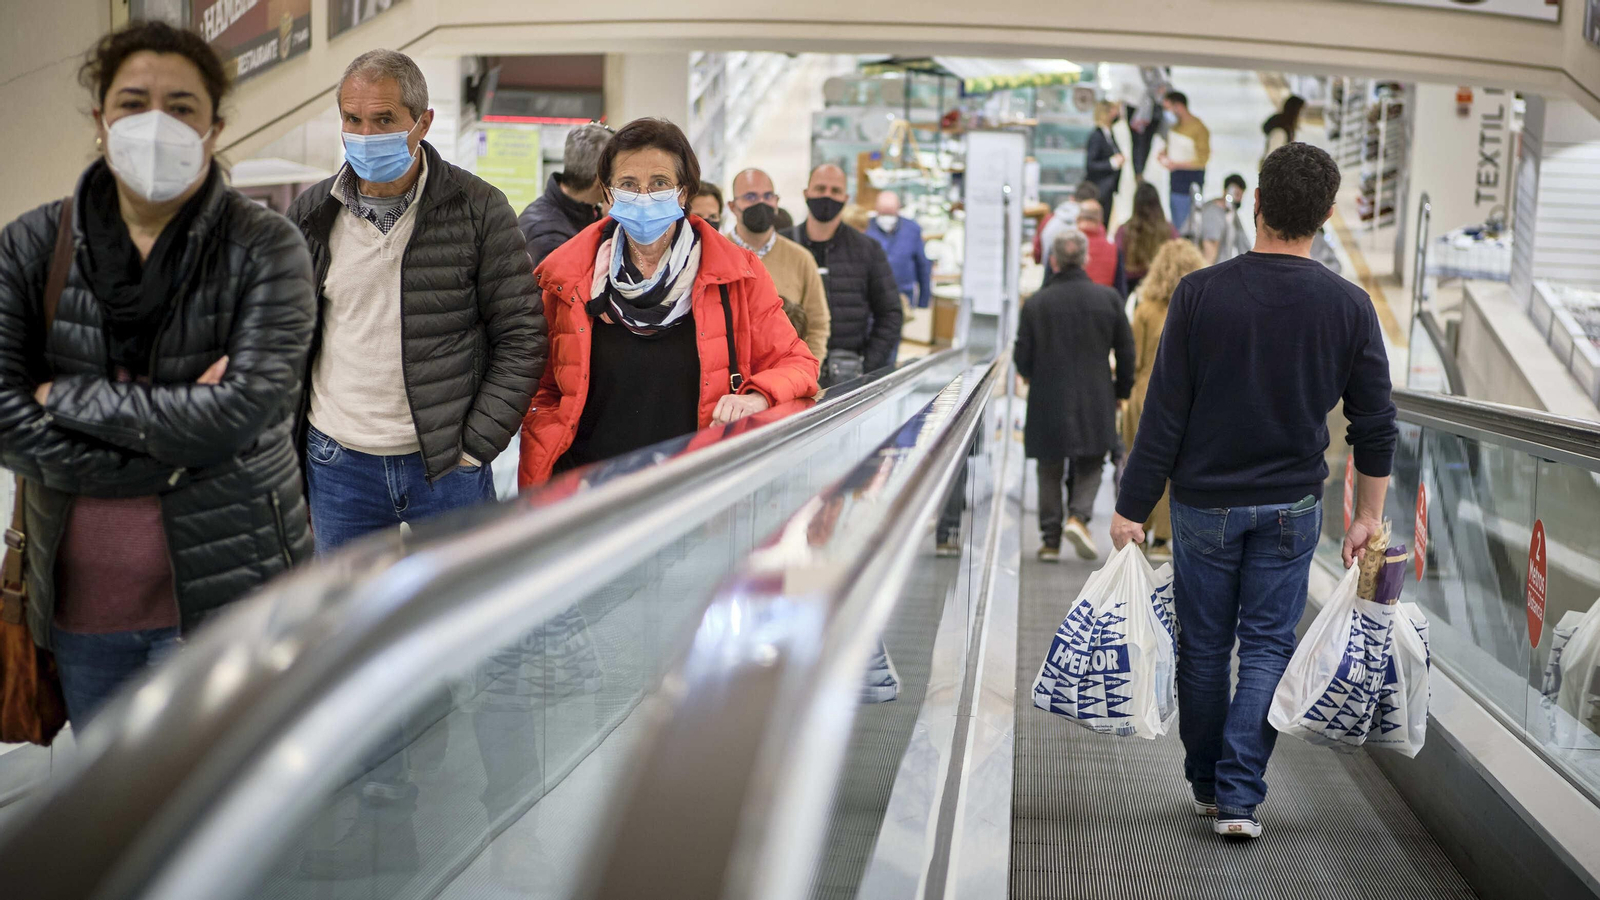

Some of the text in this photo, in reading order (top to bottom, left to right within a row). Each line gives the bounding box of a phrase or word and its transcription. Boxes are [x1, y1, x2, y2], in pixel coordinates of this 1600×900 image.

[1475, 104, 1504, 206] TEXTIL
[1536, 531, 1541, 561] 2
[1529, 558, 1545, 594] Metros
